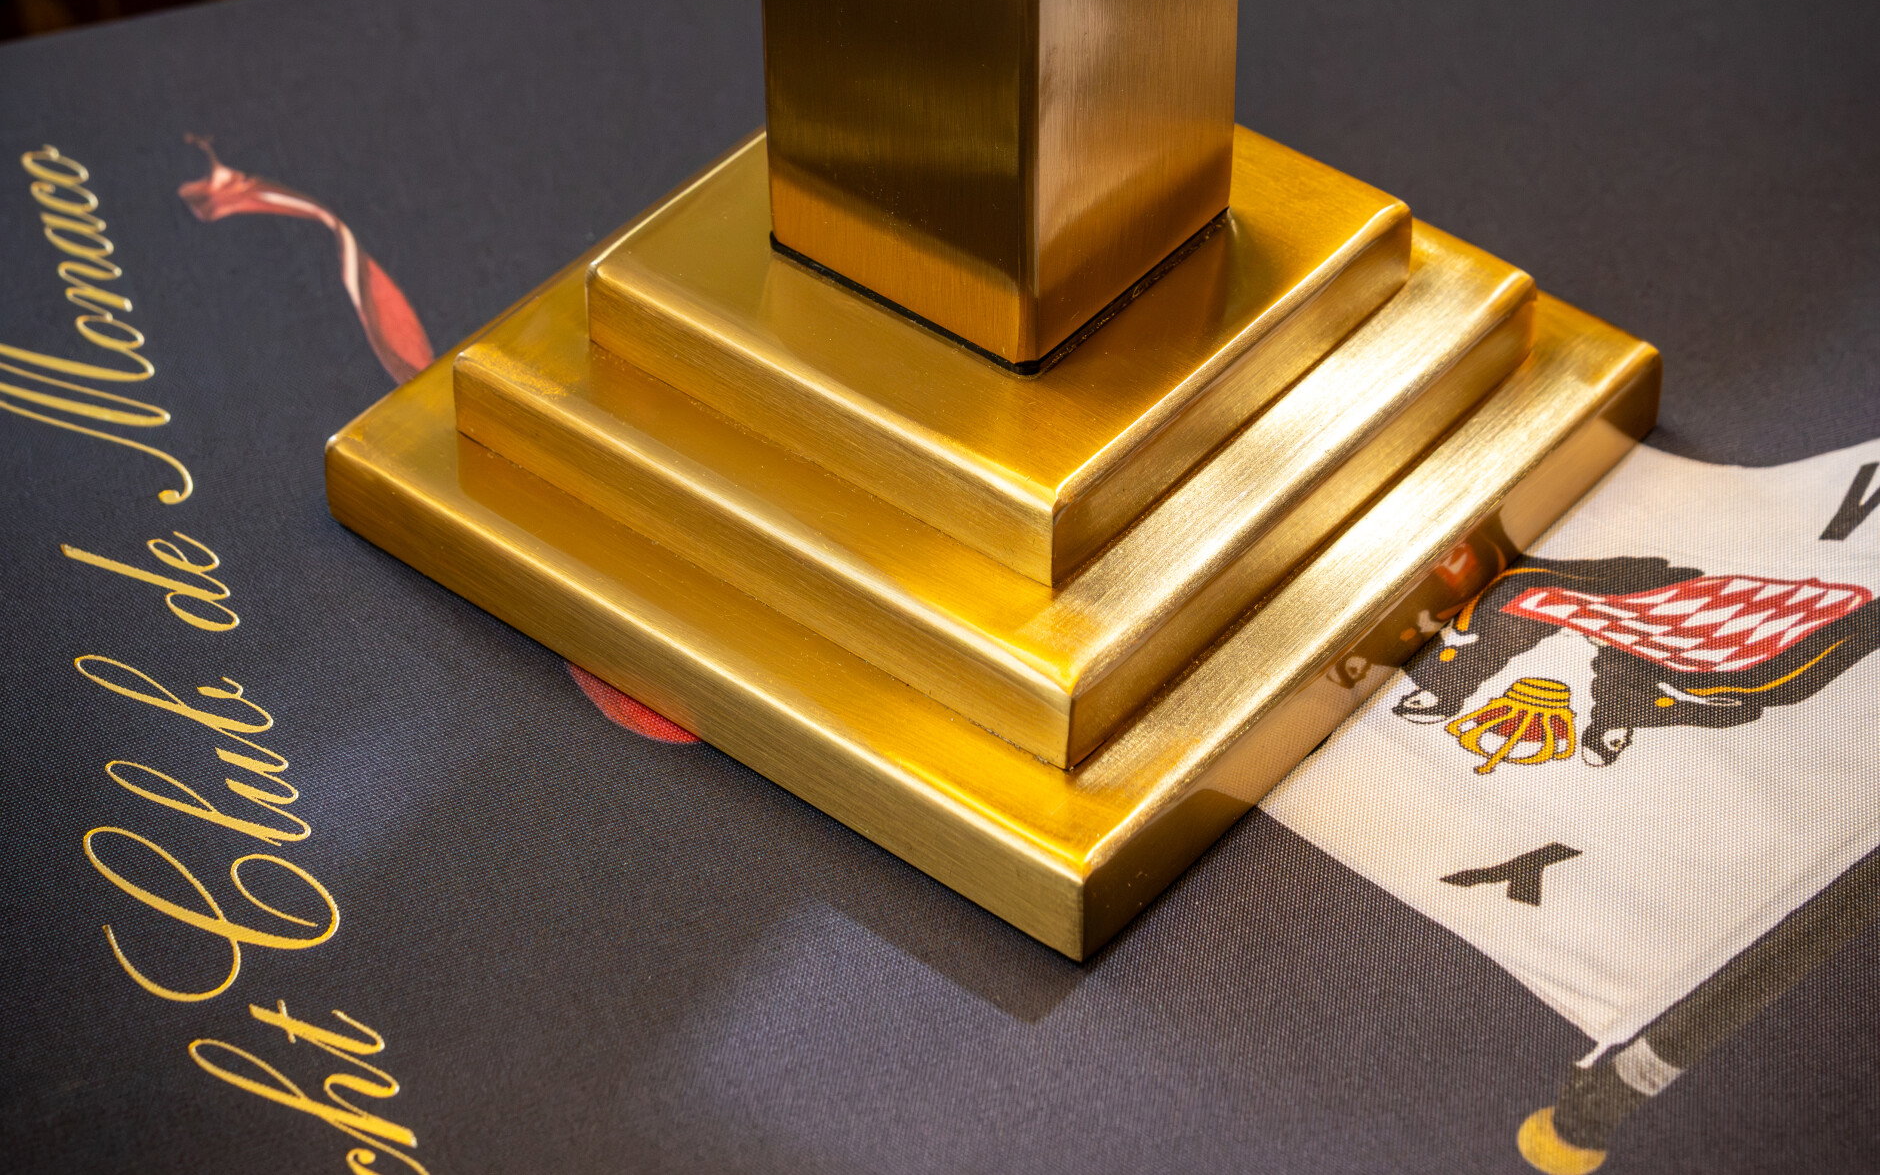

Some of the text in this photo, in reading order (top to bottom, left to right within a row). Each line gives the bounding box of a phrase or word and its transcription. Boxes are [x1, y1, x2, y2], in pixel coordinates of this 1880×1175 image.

[0, 143, 194, 505] Monaco
[60, 530, 240, 632] de
[73, 654, 340, 1003] Club
